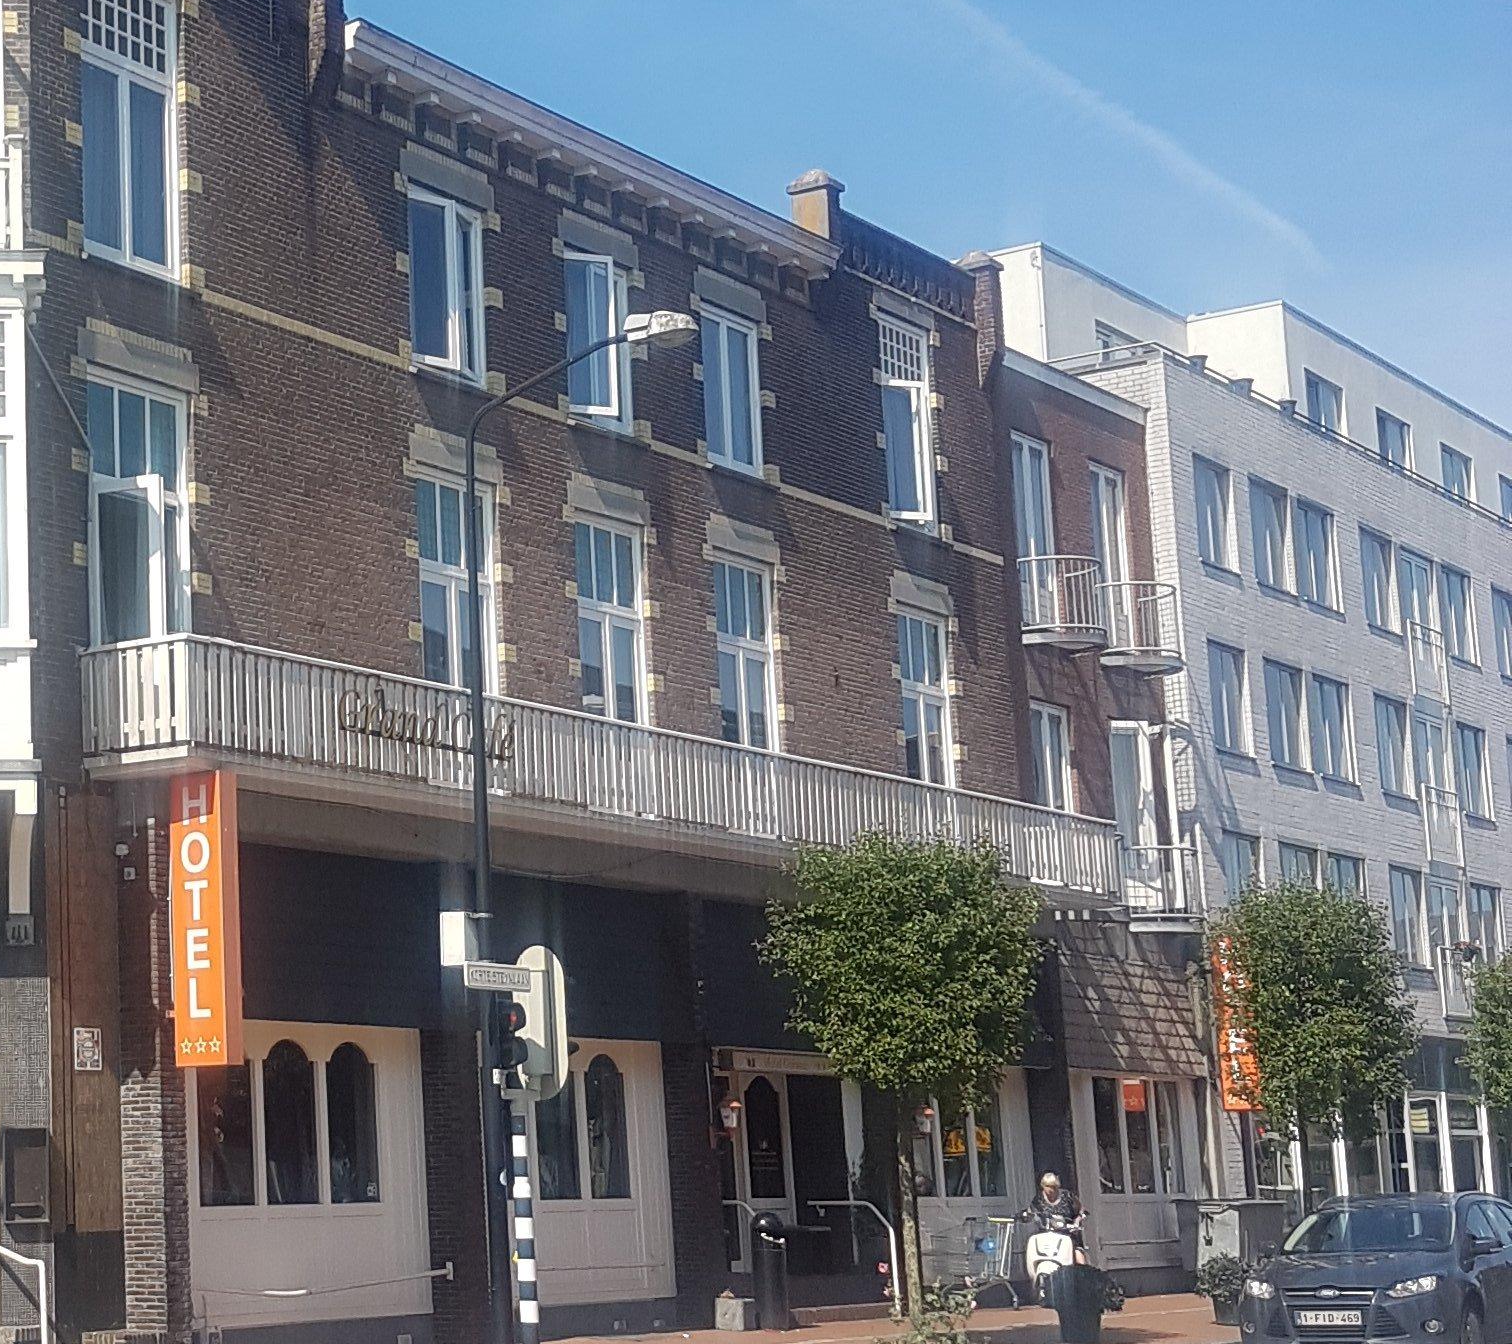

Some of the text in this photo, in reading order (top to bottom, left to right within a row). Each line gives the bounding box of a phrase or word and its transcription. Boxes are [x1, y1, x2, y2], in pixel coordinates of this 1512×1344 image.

[451, 712, 517, 761] Cfé
[181, 783, 212, 1019] HOTEL
[1304, 1313, 1360, 1323] 1-FID-469
